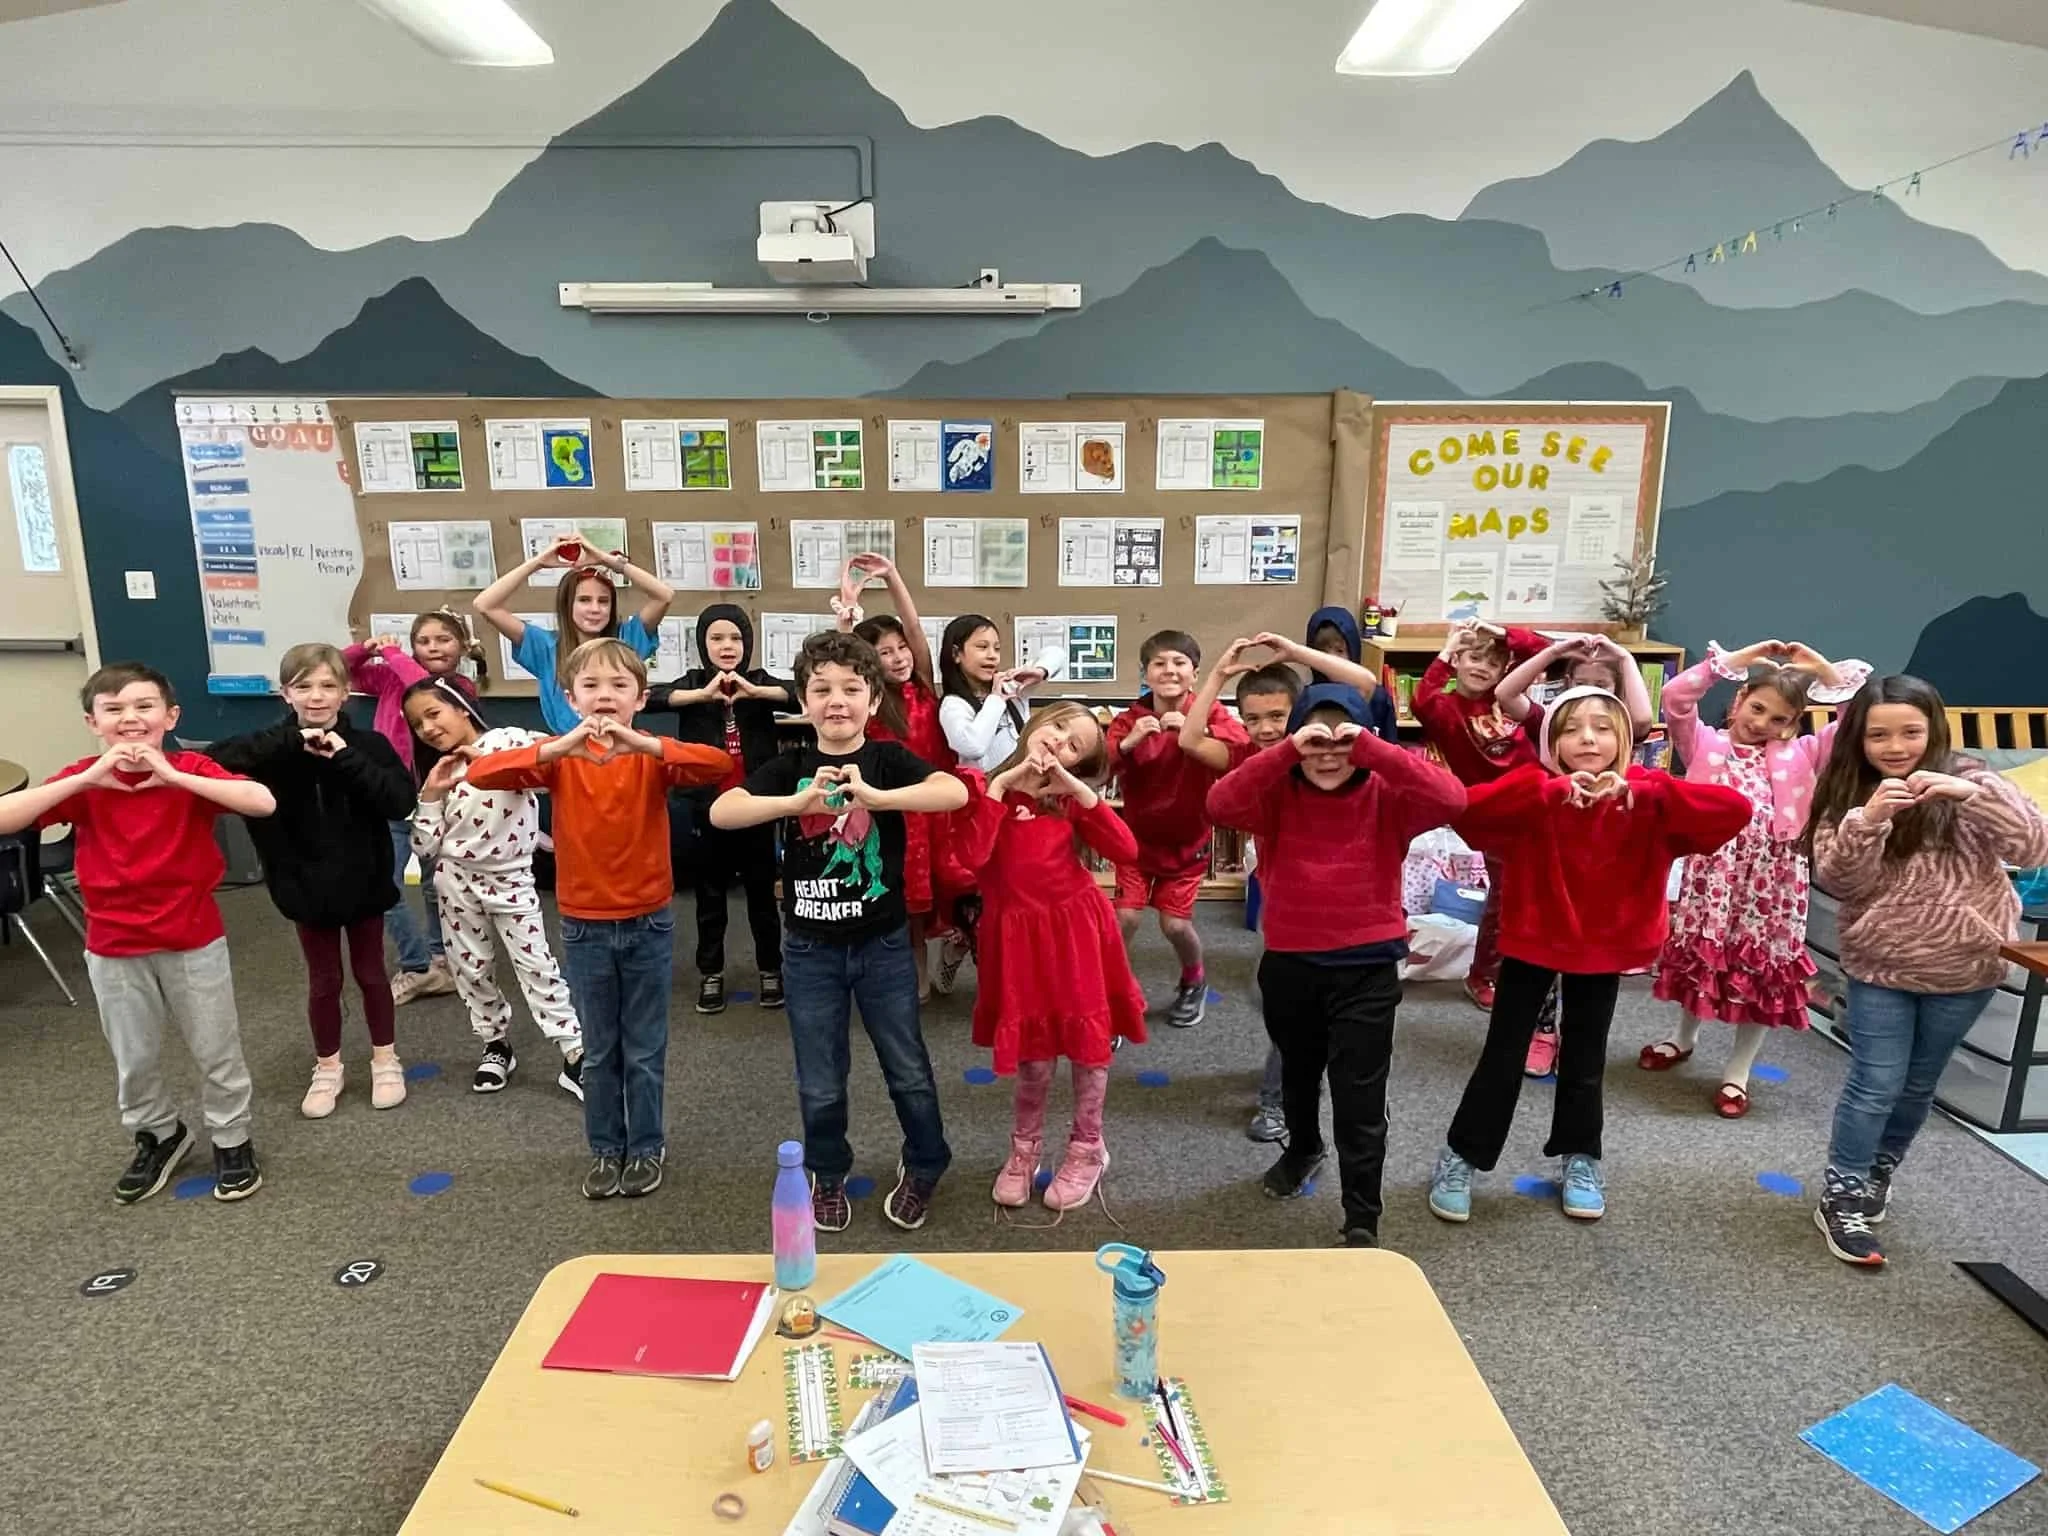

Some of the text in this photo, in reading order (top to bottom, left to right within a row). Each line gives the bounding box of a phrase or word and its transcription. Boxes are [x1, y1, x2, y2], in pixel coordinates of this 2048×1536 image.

[1408, 429, 1614, 476] COME SEE
[1472, 462, 1550, 492] OUR
[1447, 507, 1550, 541] MAPS
[794, 877, 840, 899] HEART
[794, 898, 863, 921] BREAKER
[340, 1260, 377, 1284] 20
